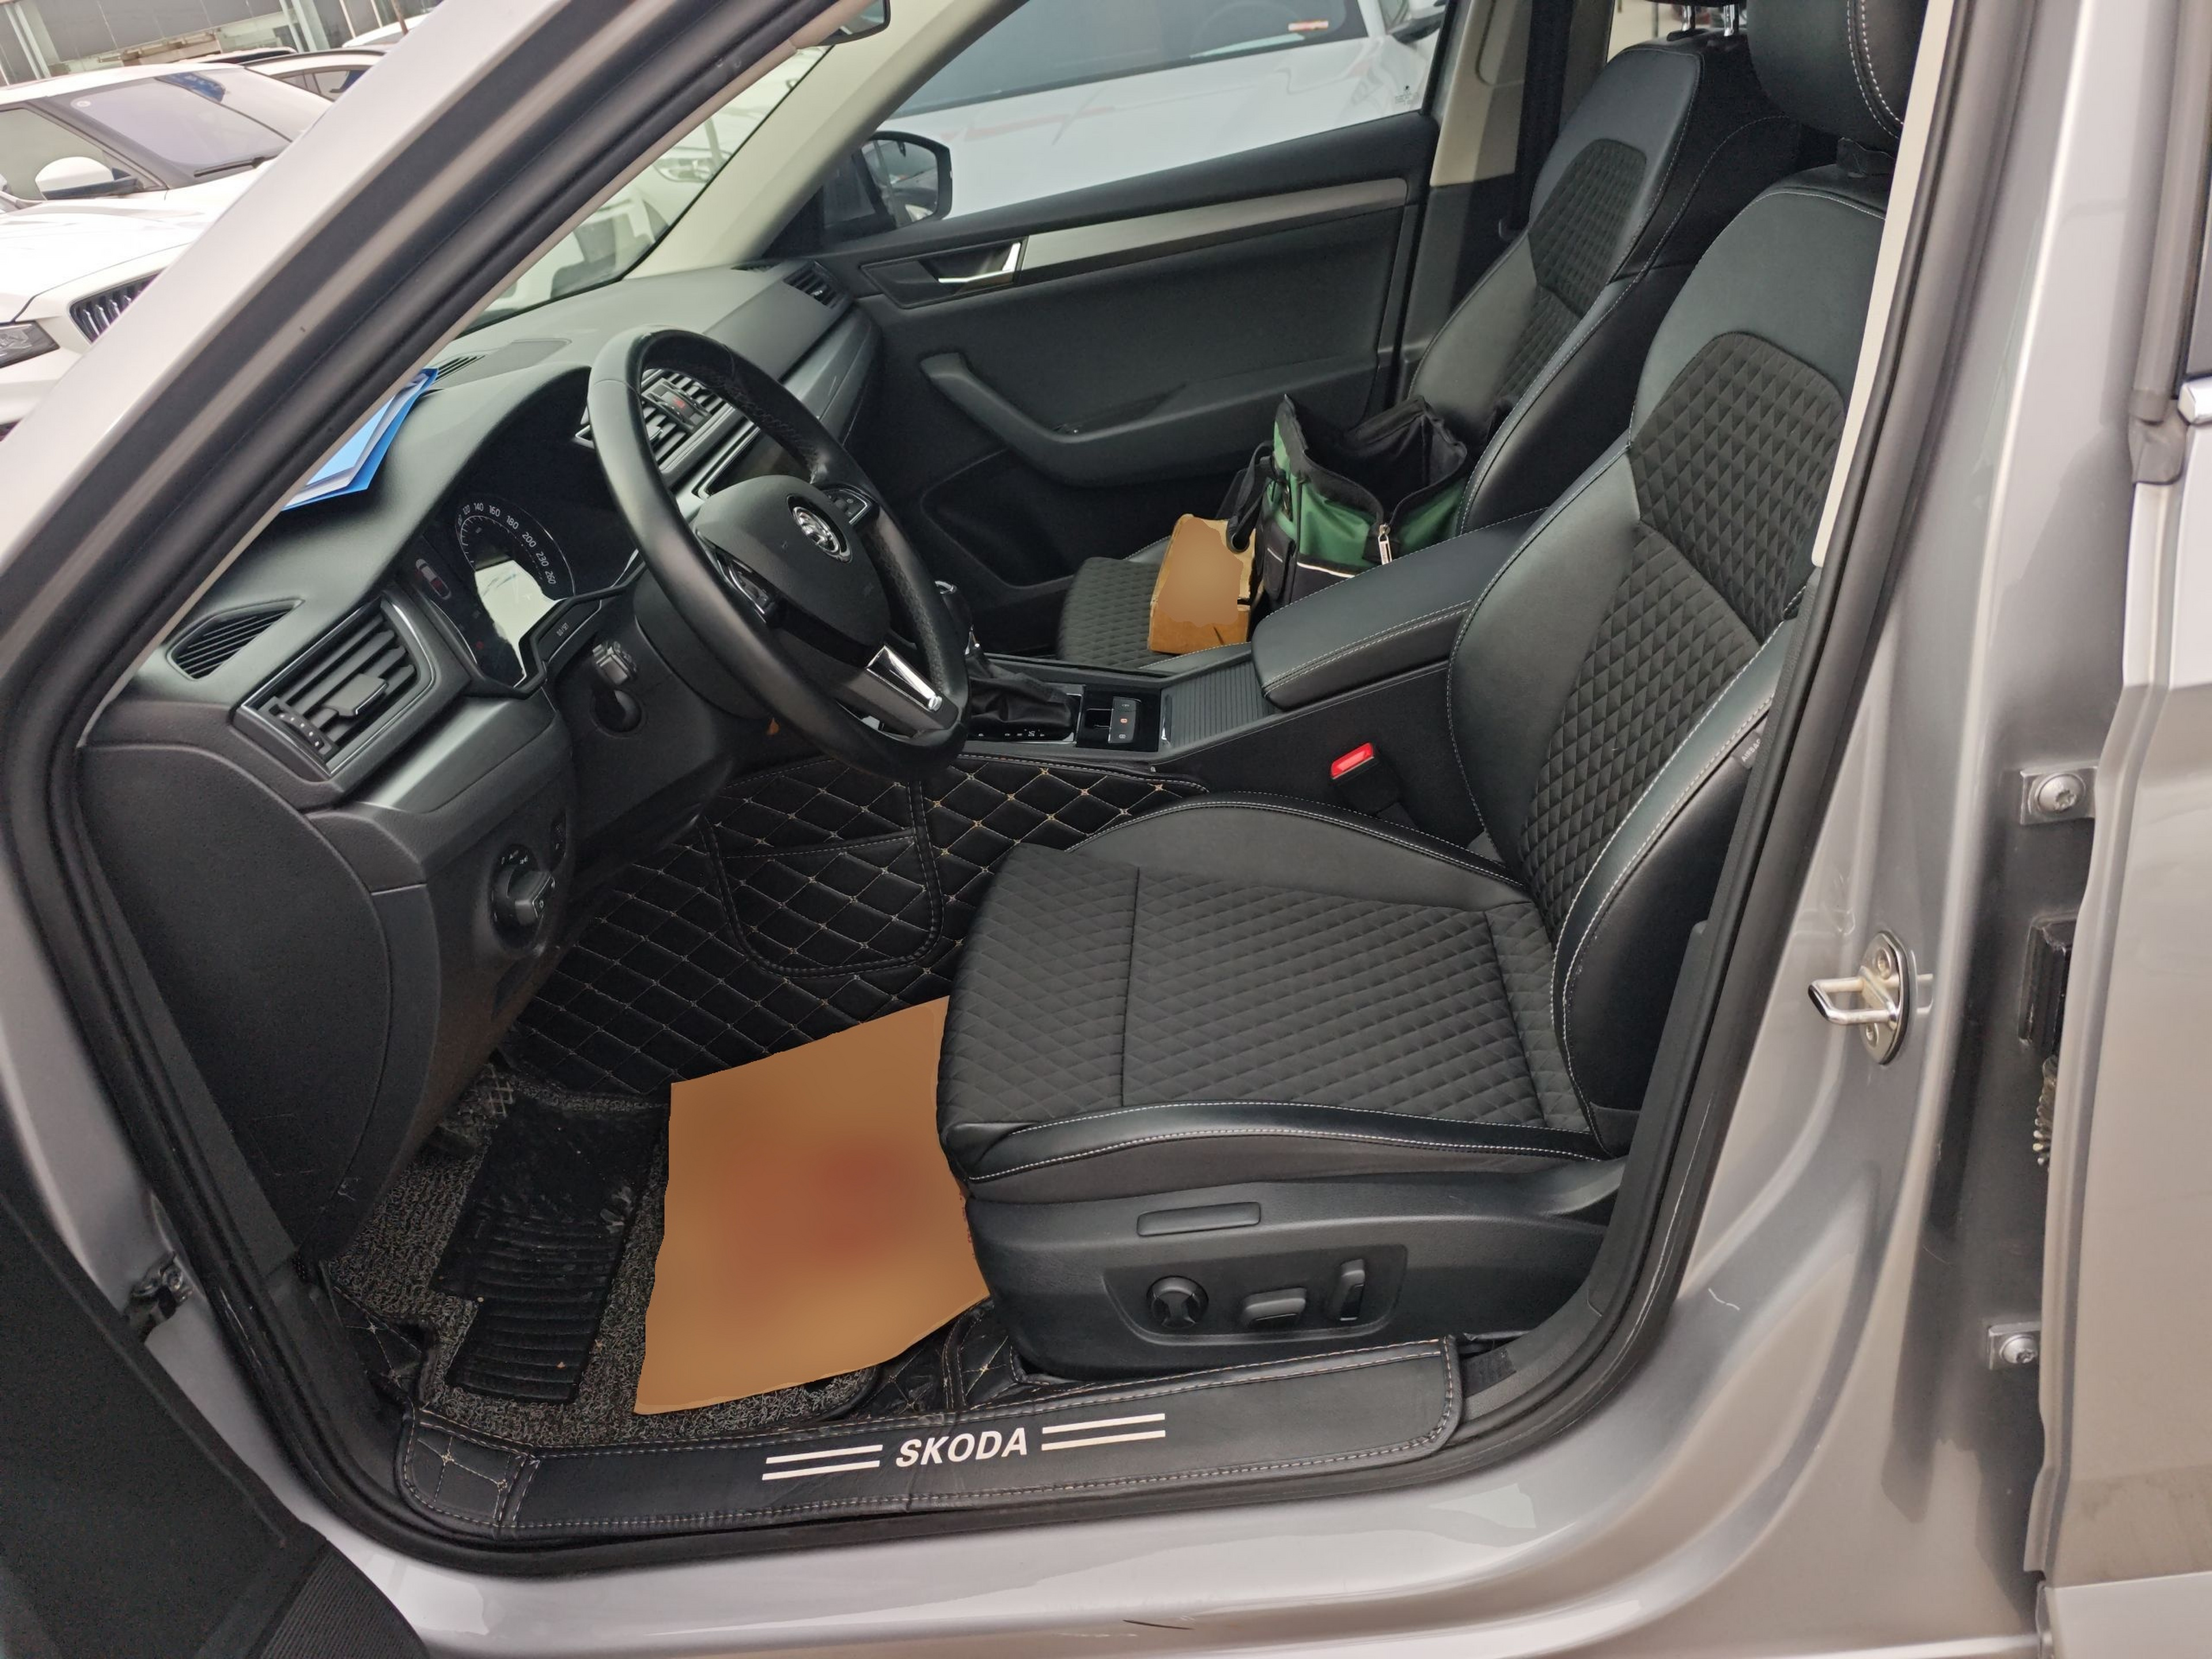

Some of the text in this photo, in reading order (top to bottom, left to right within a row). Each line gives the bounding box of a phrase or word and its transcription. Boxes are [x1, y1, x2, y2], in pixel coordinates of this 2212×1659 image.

[474, 502, 484, 512] 140
[489, 505, 501, 517] 160
[506, 516, 519, 529] 180
[522, 532, 536, 547] 200
[536, 551, 549, 566] 230
[545, 571, 556, 584] 260
[896, 1427, 1028, 1467] SKODA
